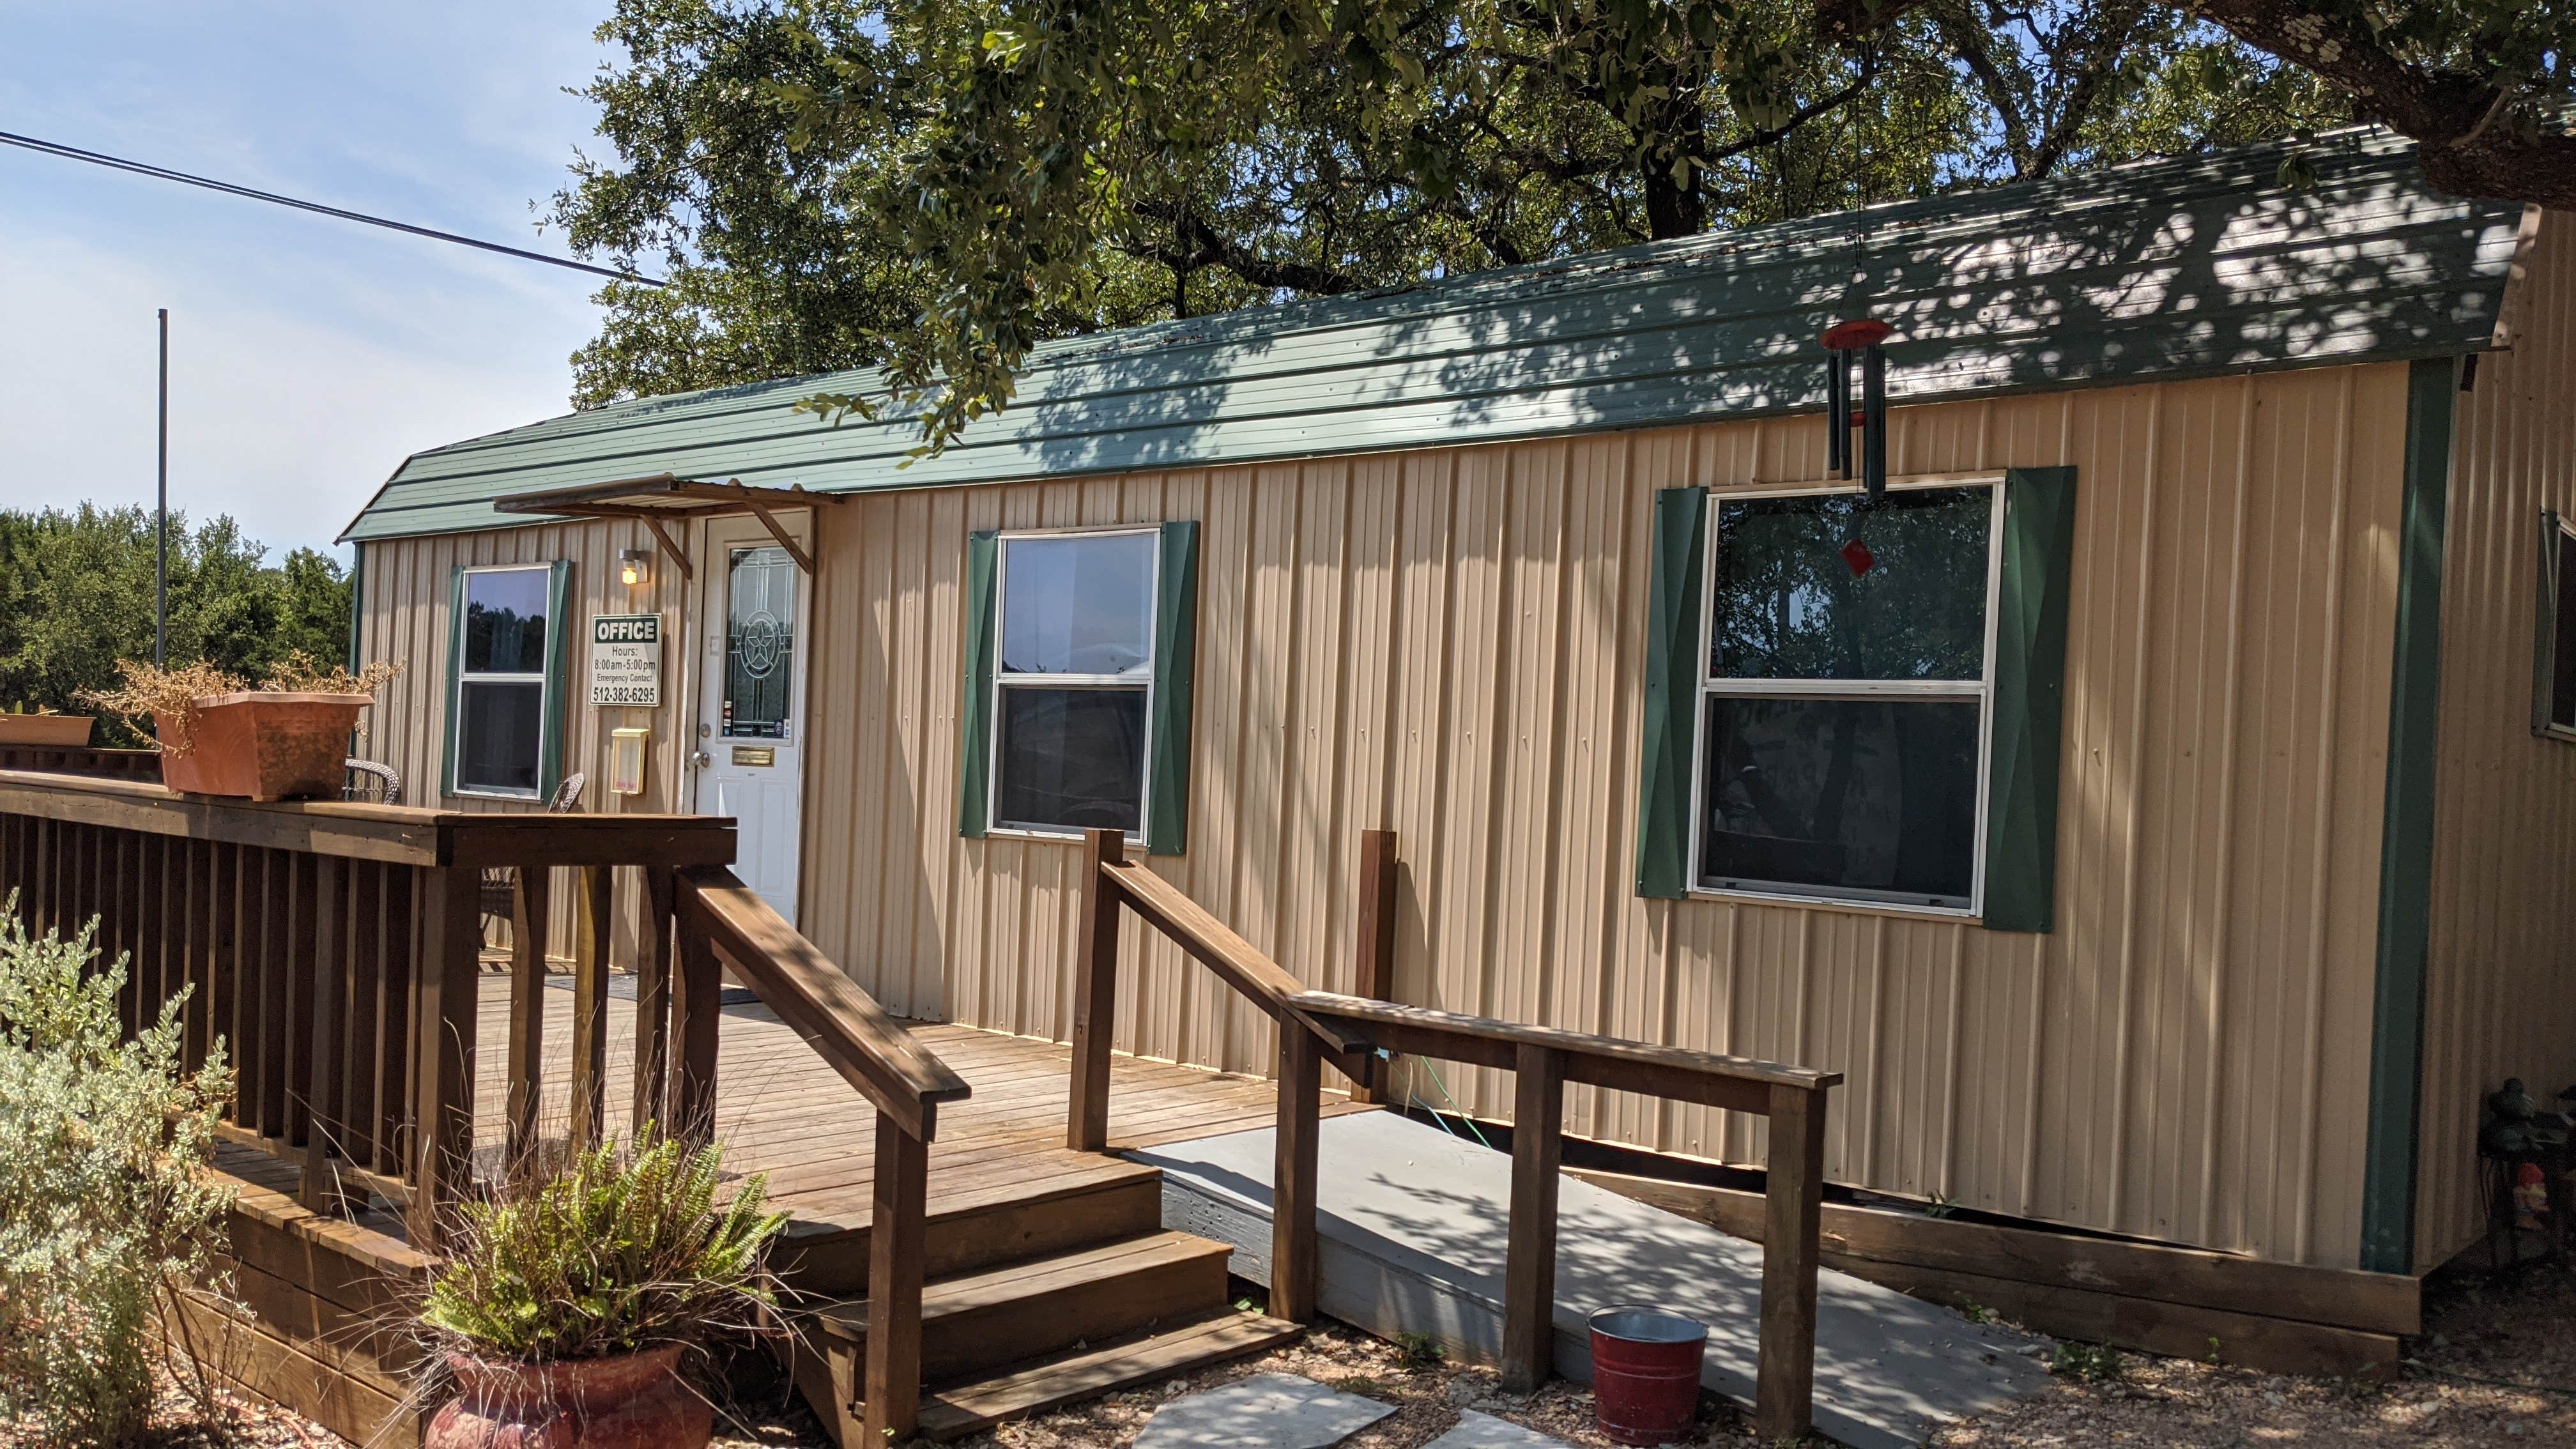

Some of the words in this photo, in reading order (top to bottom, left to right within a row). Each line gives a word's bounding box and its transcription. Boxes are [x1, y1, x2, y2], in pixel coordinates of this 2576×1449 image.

[597, 622, 655, 640] OFFICE
[612, 645, 638, 656] Hours:
[597, 673, 628, 684] Emergency
[630, 674, 652, 682] Contact
[593, 687, 655, 702] 512-382-6295
